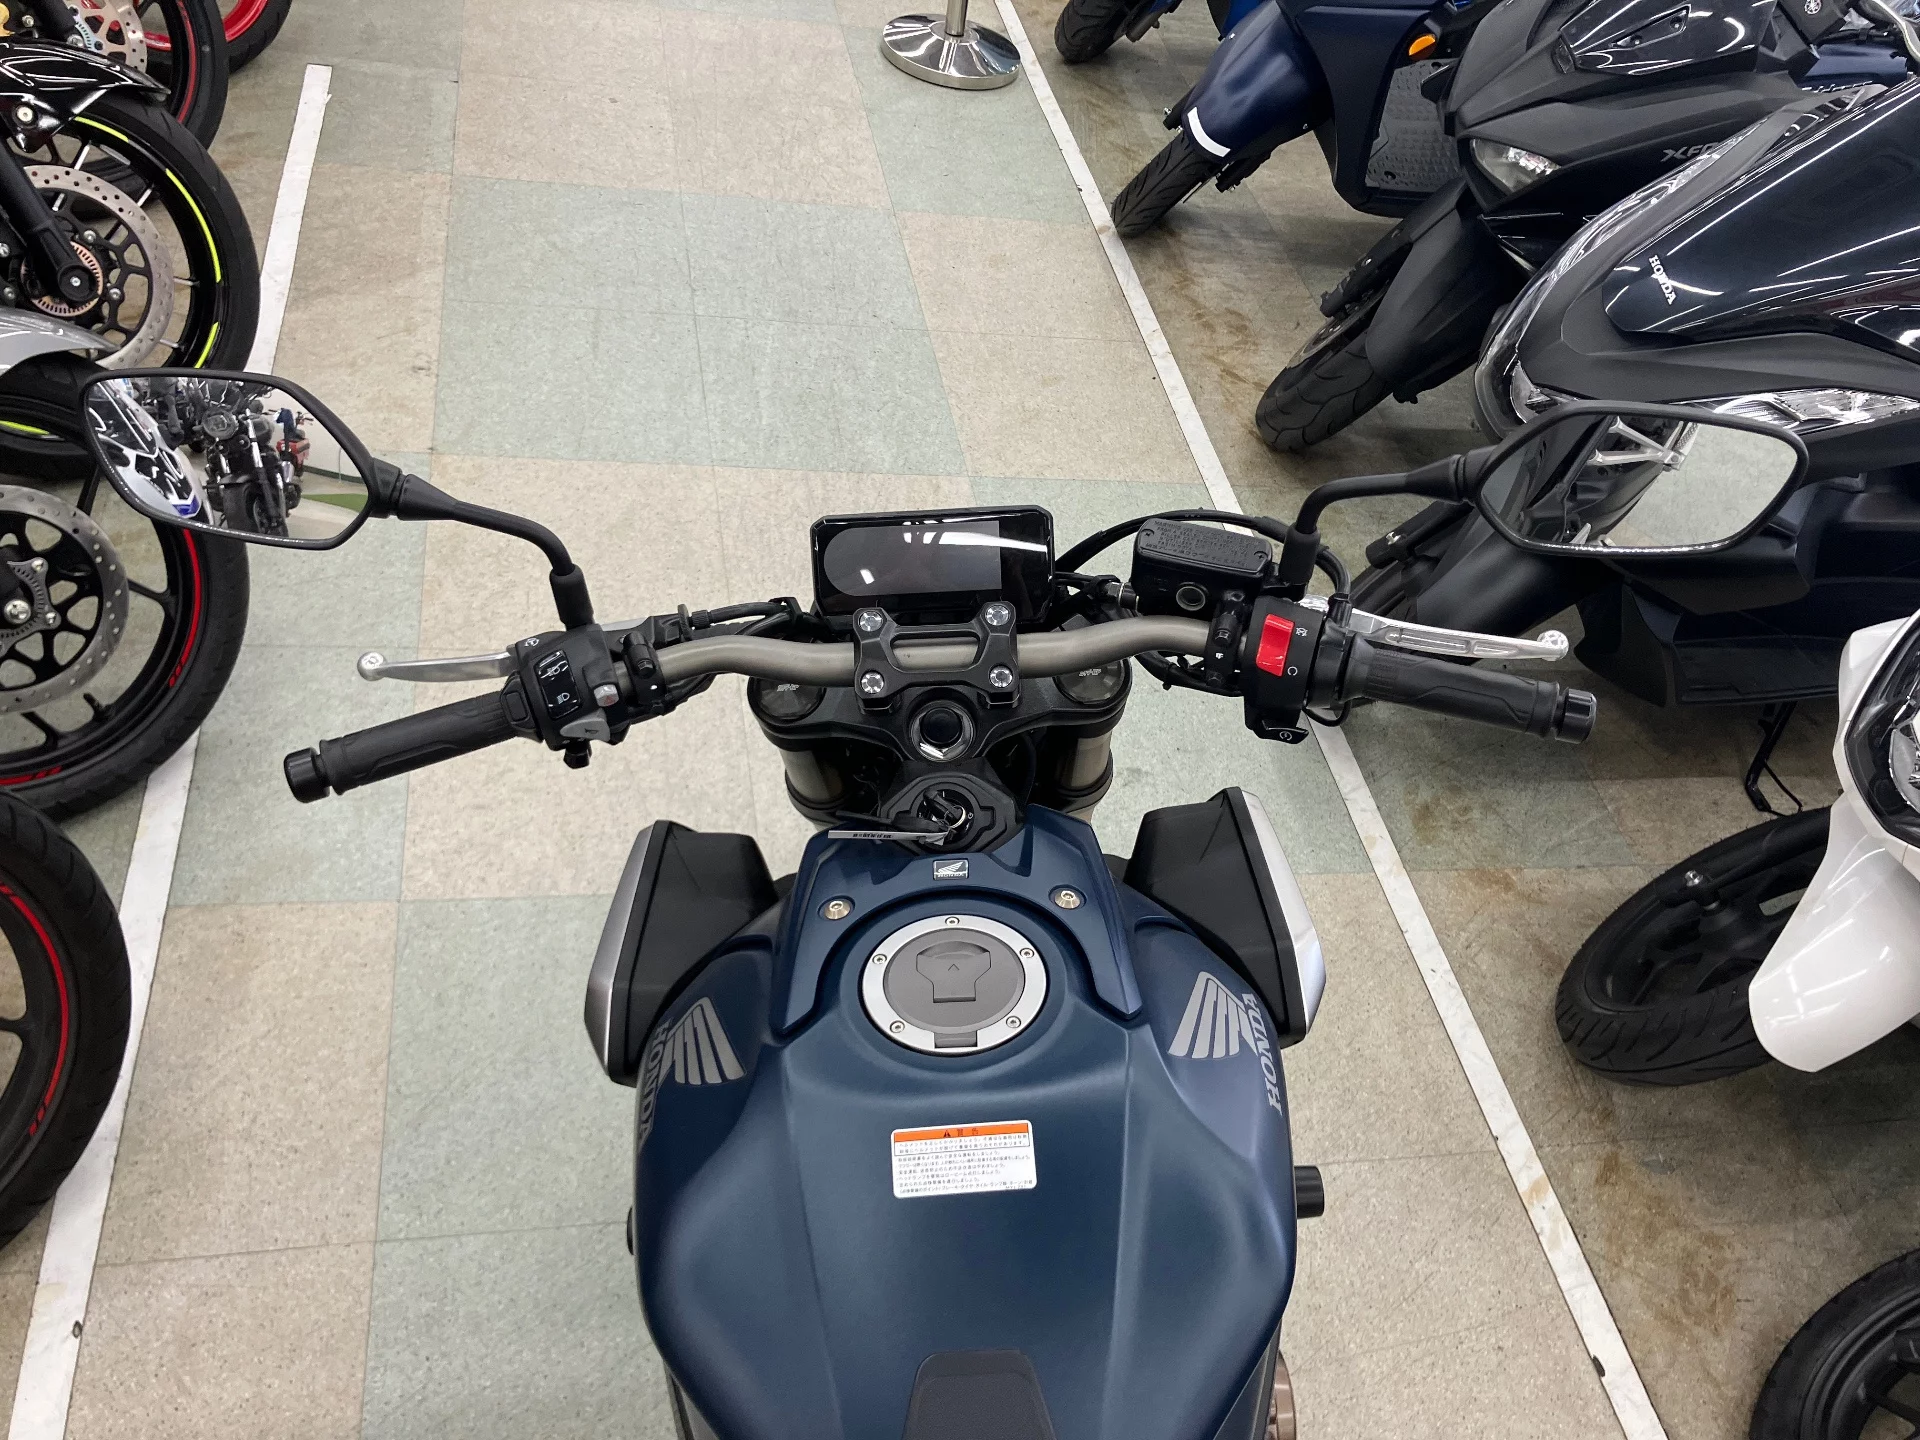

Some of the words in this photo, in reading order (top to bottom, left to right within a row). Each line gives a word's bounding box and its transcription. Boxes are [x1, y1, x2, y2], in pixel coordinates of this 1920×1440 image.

[1648, 255, 1677, 305] HONDA
[636, 1017, 673, 1148] HONDA
[1242, 993, 1283, 1116] HONDA
